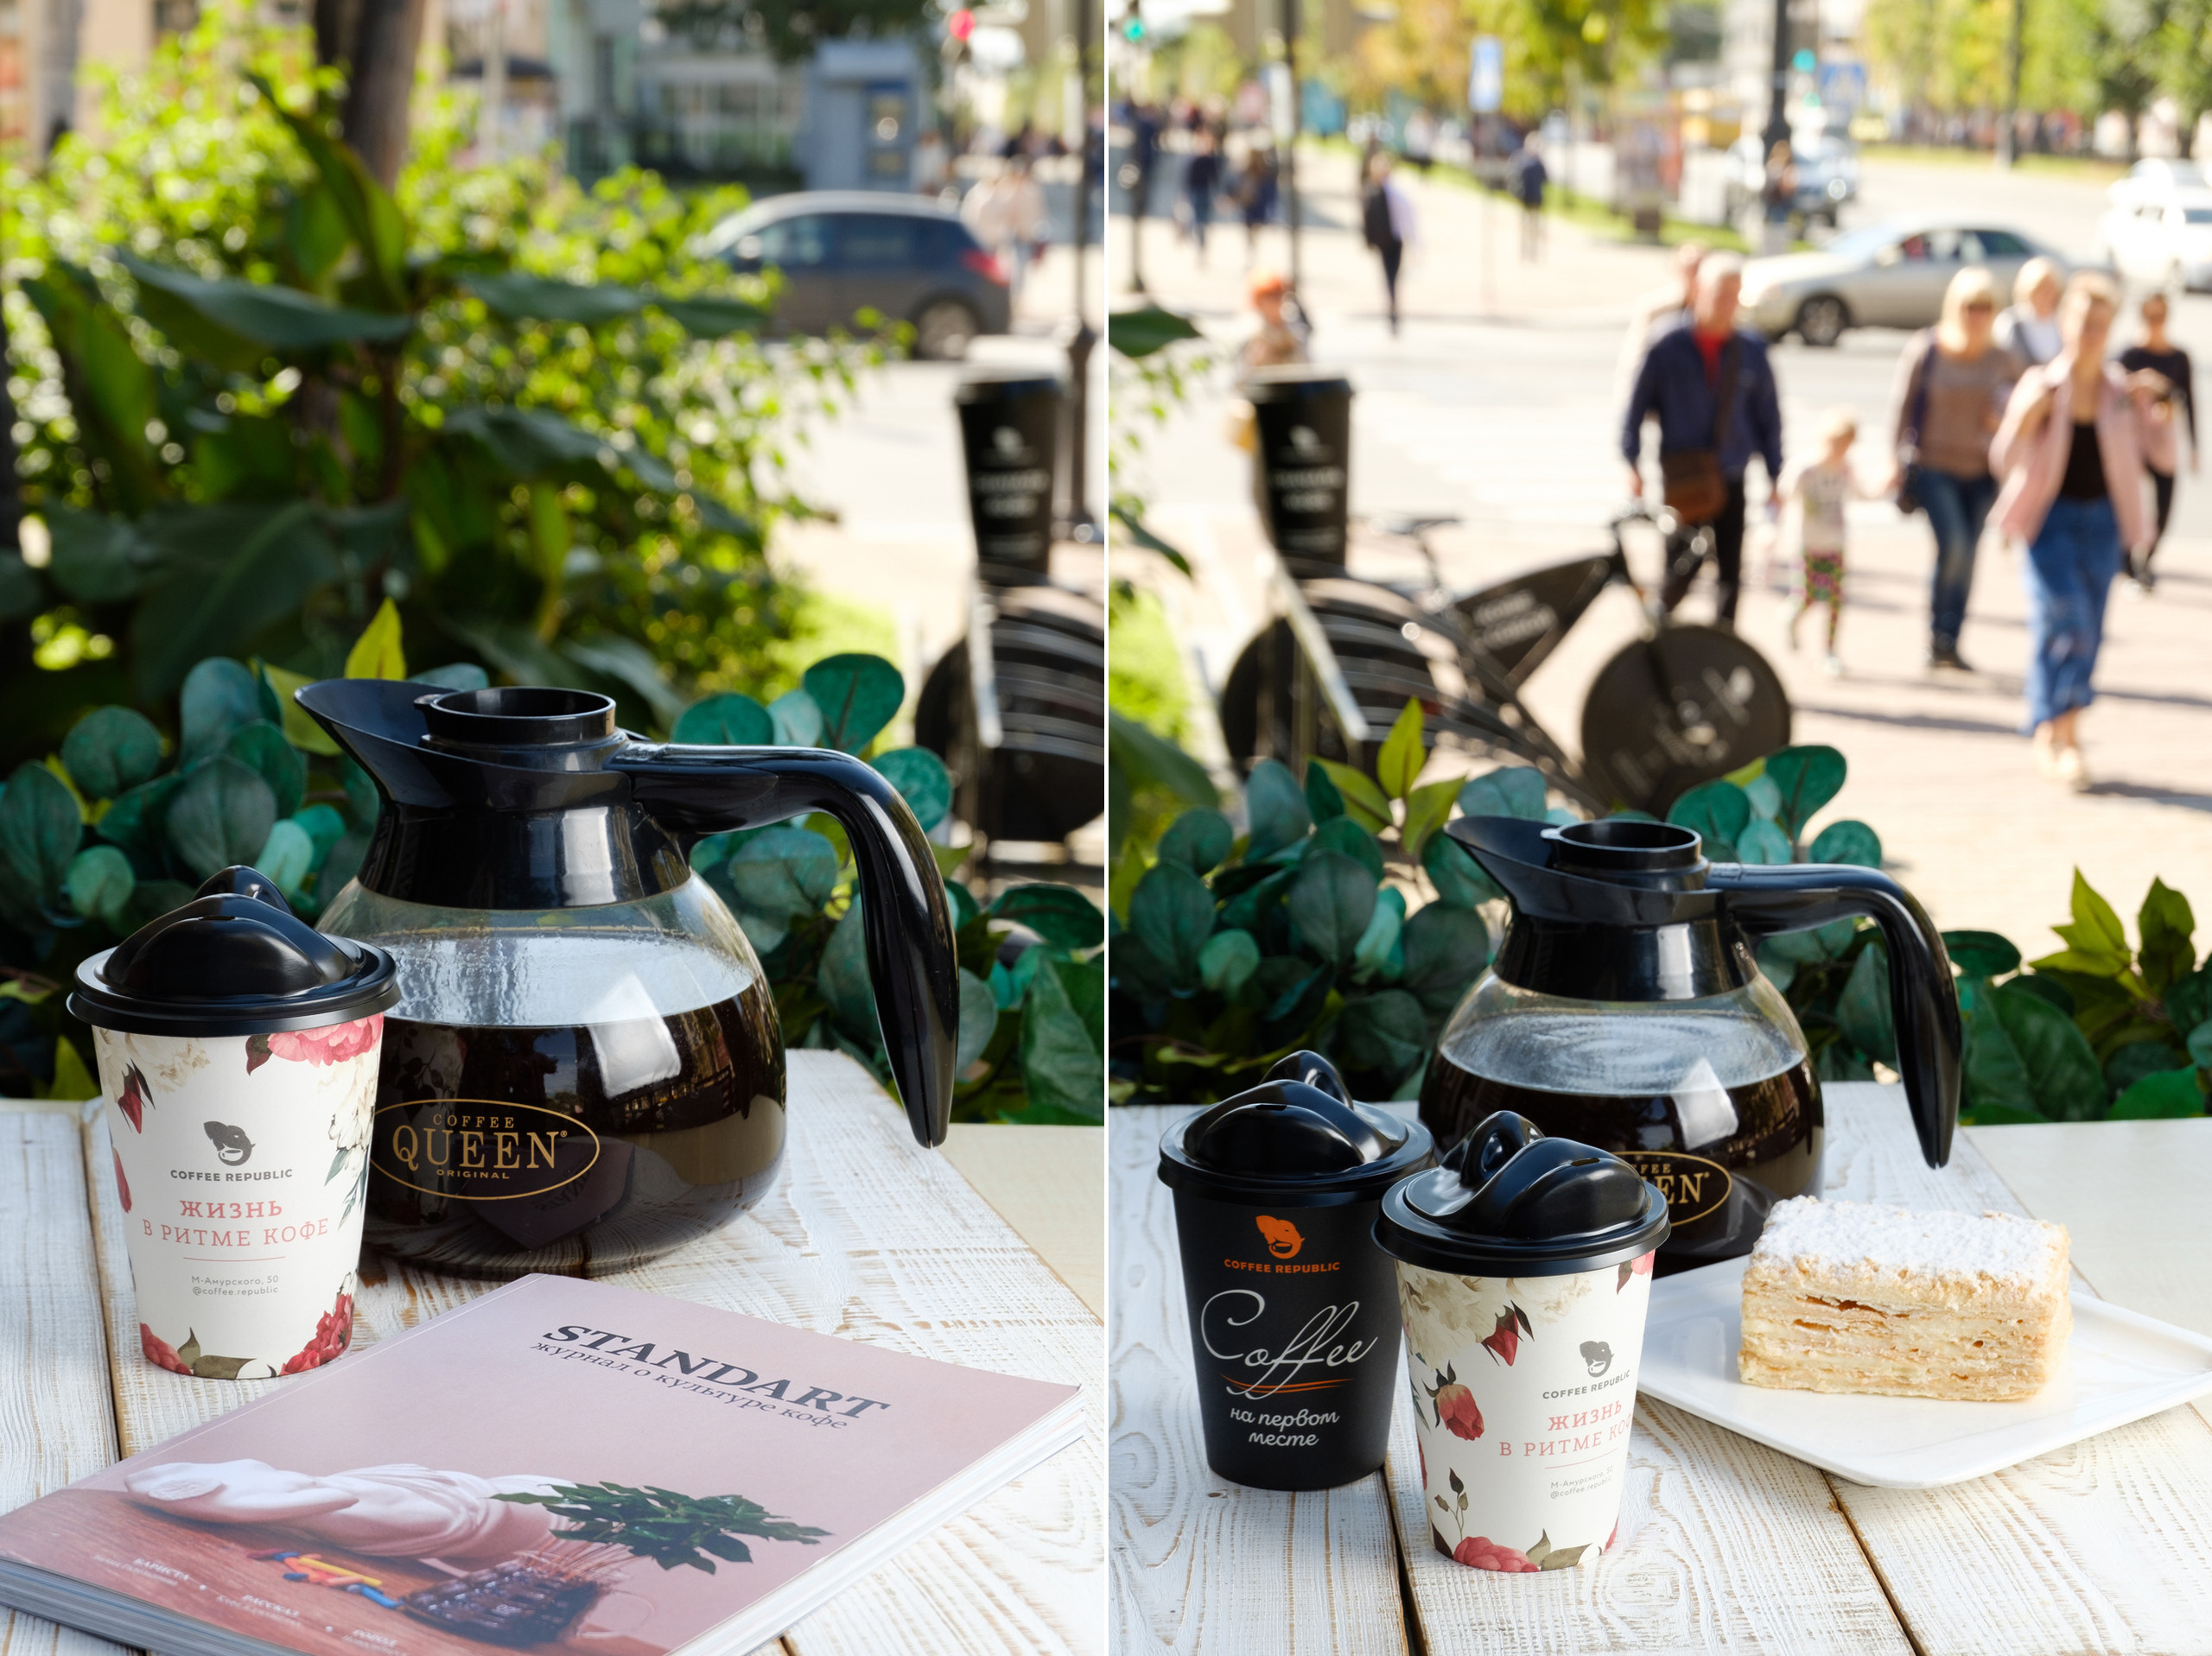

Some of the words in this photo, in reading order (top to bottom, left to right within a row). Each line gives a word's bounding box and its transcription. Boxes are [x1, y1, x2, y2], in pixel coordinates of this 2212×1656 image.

[433, 1114, 514, 1129] COFFEE
[170, 1170, 221, 1182] COFFEE
[226, 1169, 293, 1182] REPUBLIC
[435, 1169, 510, 1180] ORIGINAL
[179, 1200, 283, 1219] ЖИЗНЬ
[143, 1219, 154, 1236] В
[161, 1223, 251, 1247] РИТМЕ
[263, 1217, 329, 1245] КОФЕ
[1224, 1259, 1271, 1273] COFFEE
[1275, 1261, 1340, 1274] REPUBLIC
[266, 1274, 279, 1284] 50
[192, 1285, 279, 1297] @coffee.republic
[1200, 1288, 1379, 1400] Coffee
[542, 1325, 892, 1418] STANDART
[530, 1342, 632, 1373] журнал
[633, 1368, 652, 1377] о
[652, 1374, 777, 1412] культуре
[778, 1407, 848, 1430] кофе
[1541, 1385, 1588, 1399] COFFEE
[1590, 1369, 1630, 1393] REPUBLIC
[1230, 1407, 1255, 1424] на
[1257, 1408, 1341, 1432] первом
[1548, 1399, 1623, 1431] ЖИЗНЬ
[1248, 1431, 1319, 1447] месте
[1499, 1441, 1512, 1456] В
[1523, 1431, 1602, 1456] РИТМЕ
